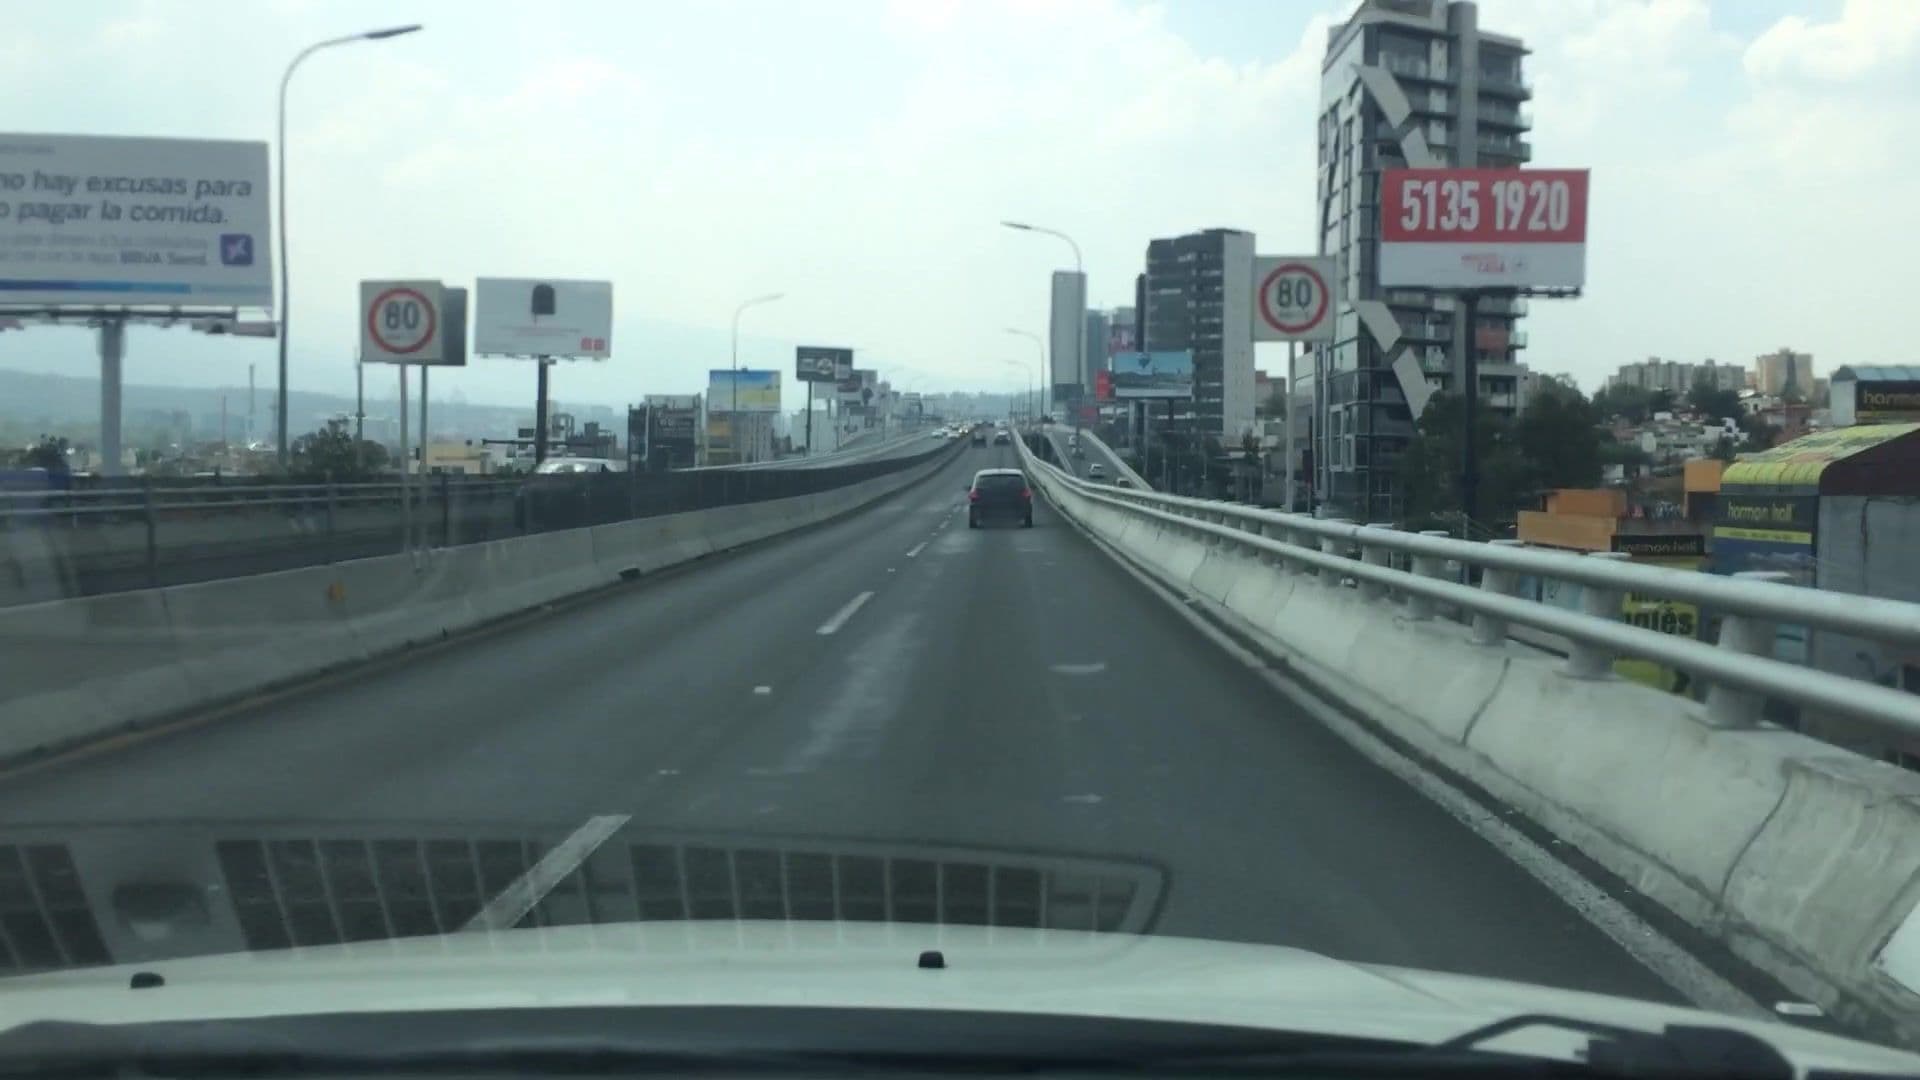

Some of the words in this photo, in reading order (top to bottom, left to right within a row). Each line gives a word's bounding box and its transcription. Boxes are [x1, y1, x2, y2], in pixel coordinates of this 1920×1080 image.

[34, 169, 77, 197] hay
[86, 175, 187, 194] excusas
[195, 178, 253, 201] para
[17, 203, 91, 225] pagar
[101, 201, 122, 221] la
[130, 203, 228, 225] comida.
[1401, 180, 1480, 232] 5135
[1491, 180, 1570, 232] 1920
[1277, 277, 1312, 308] 80
[384, 301, 419, 329] 80
